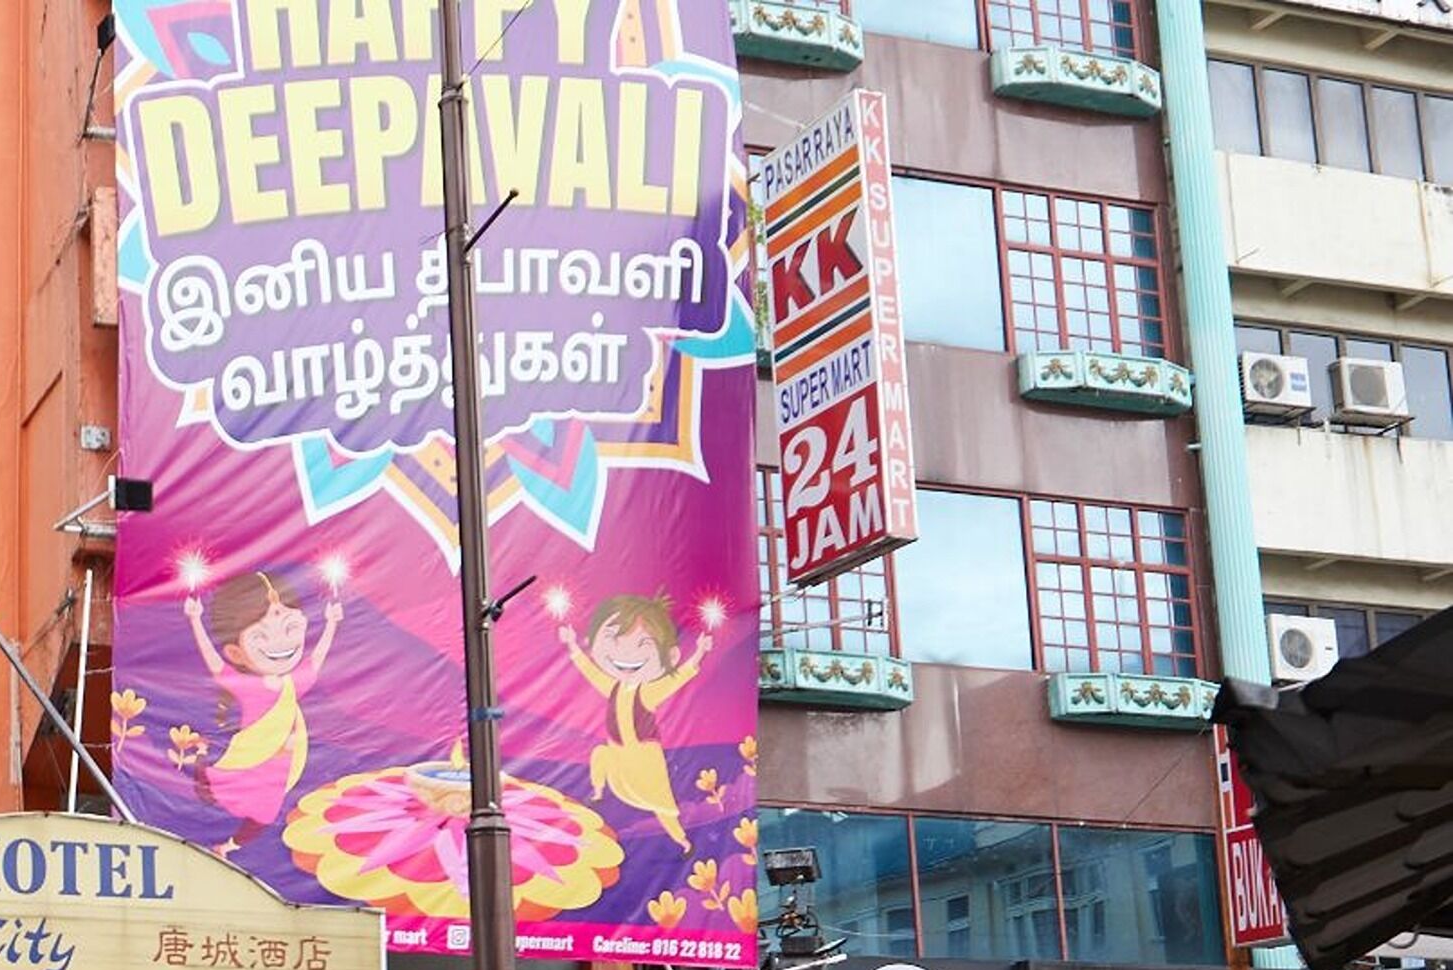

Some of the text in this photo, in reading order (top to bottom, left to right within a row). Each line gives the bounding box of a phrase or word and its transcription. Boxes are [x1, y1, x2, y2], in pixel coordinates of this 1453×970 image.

[138, 74, 705, 237] DEEPAVALI
[157, 238, 395, 353] இனிய
[770, 207, 865, 324] KK
[782, 395, 880, 520] 24
[790, 483, 886, 572] JAM
[392, 928, 428, 948] mart
[1231, 838, 1281, 933] BUKA
[591, 934, 652, 955] Careline:
[680, 941, 699, 958] 22
[724, 943, 742, 960] 22
